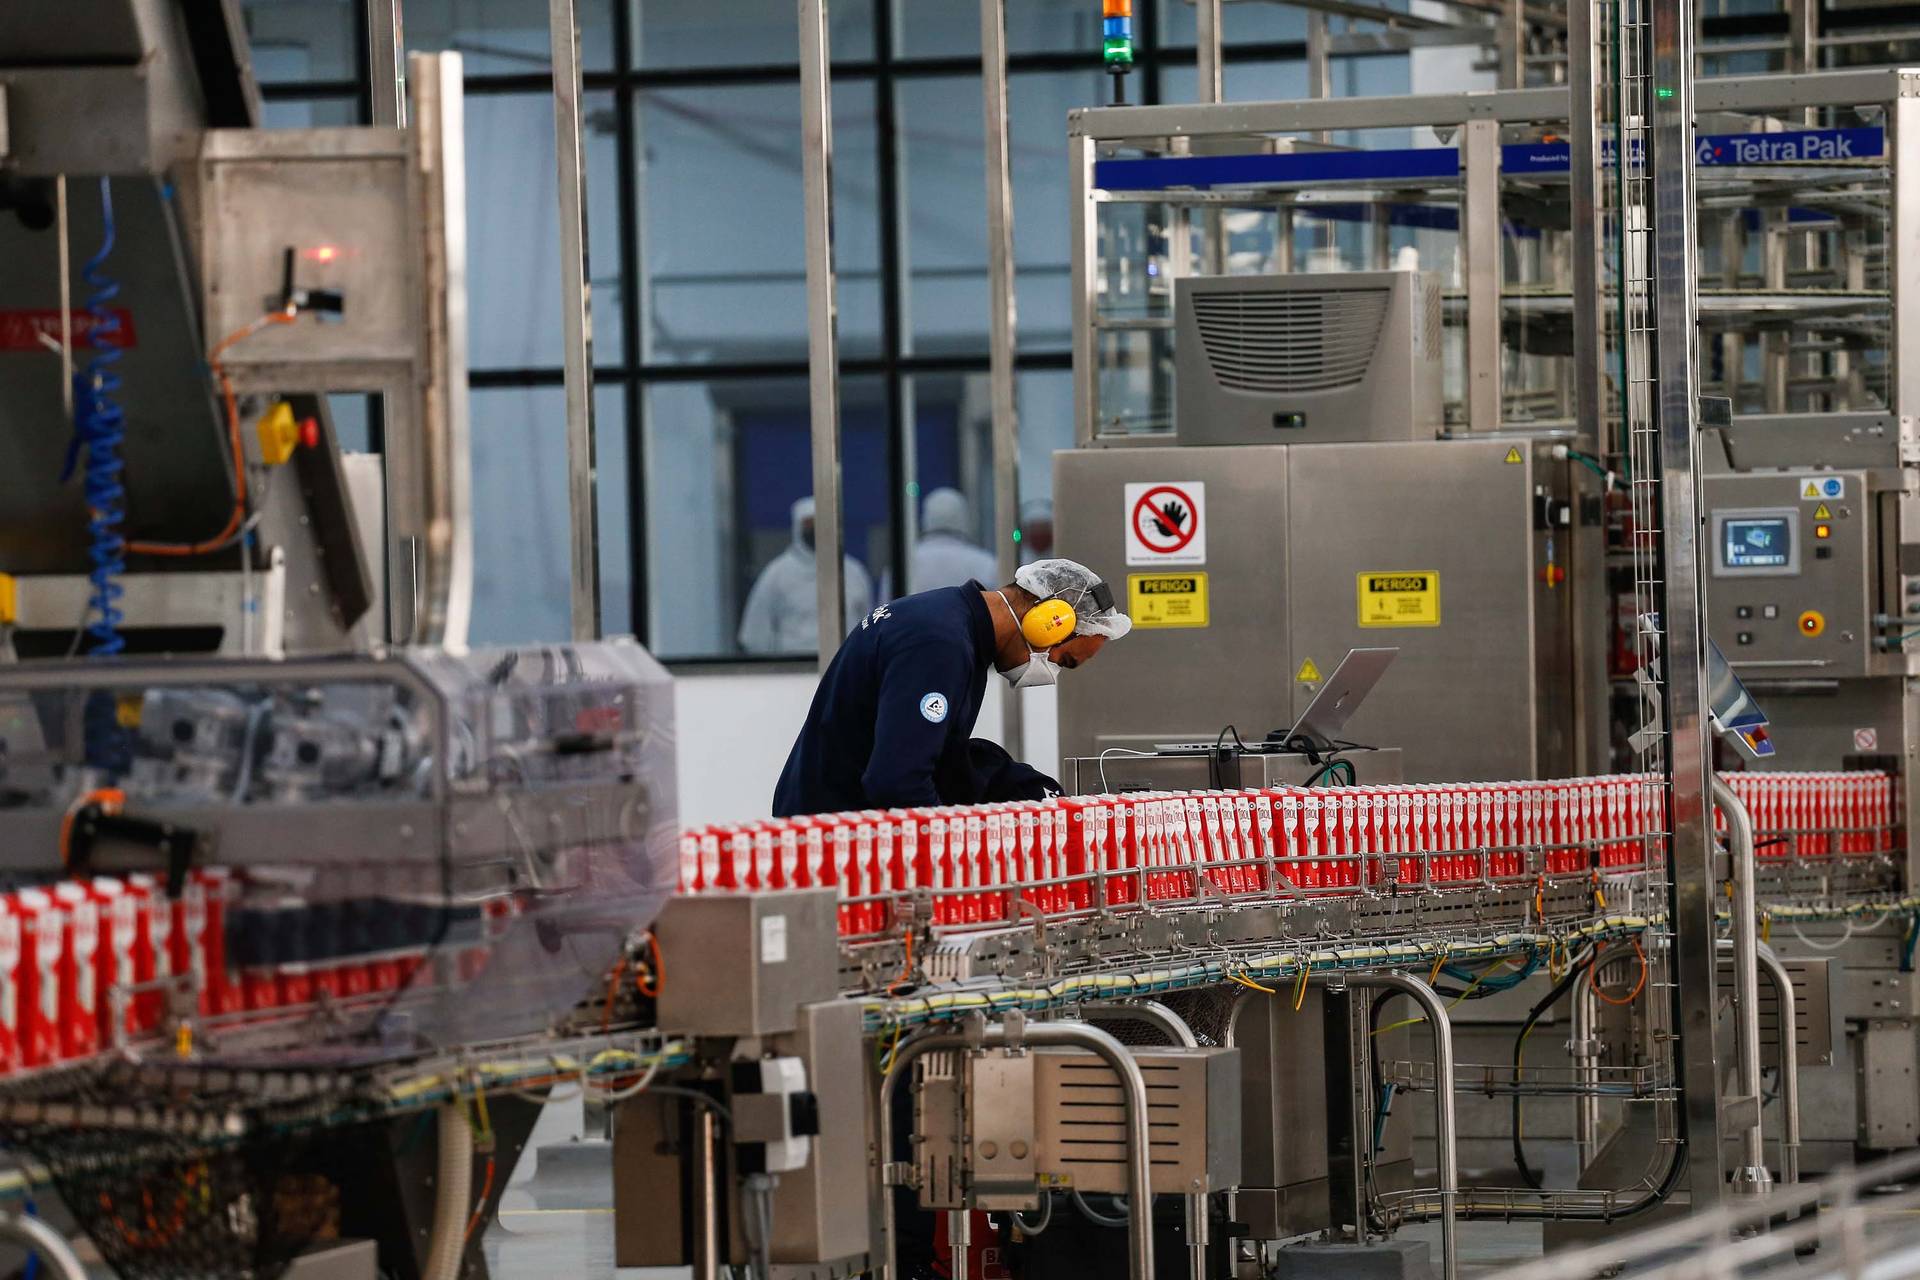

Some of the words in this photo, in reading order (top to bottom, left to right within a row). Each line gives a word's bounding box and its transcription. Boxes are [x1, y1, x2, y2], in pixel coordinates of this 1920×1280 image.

[1730, 138, 1799, 162] Tetra
[1803, 134, 1852, 160] Pak
[1144, 579, 1191, 592] PERIGO
[1375, 578, 1422, 590] PERIGO
